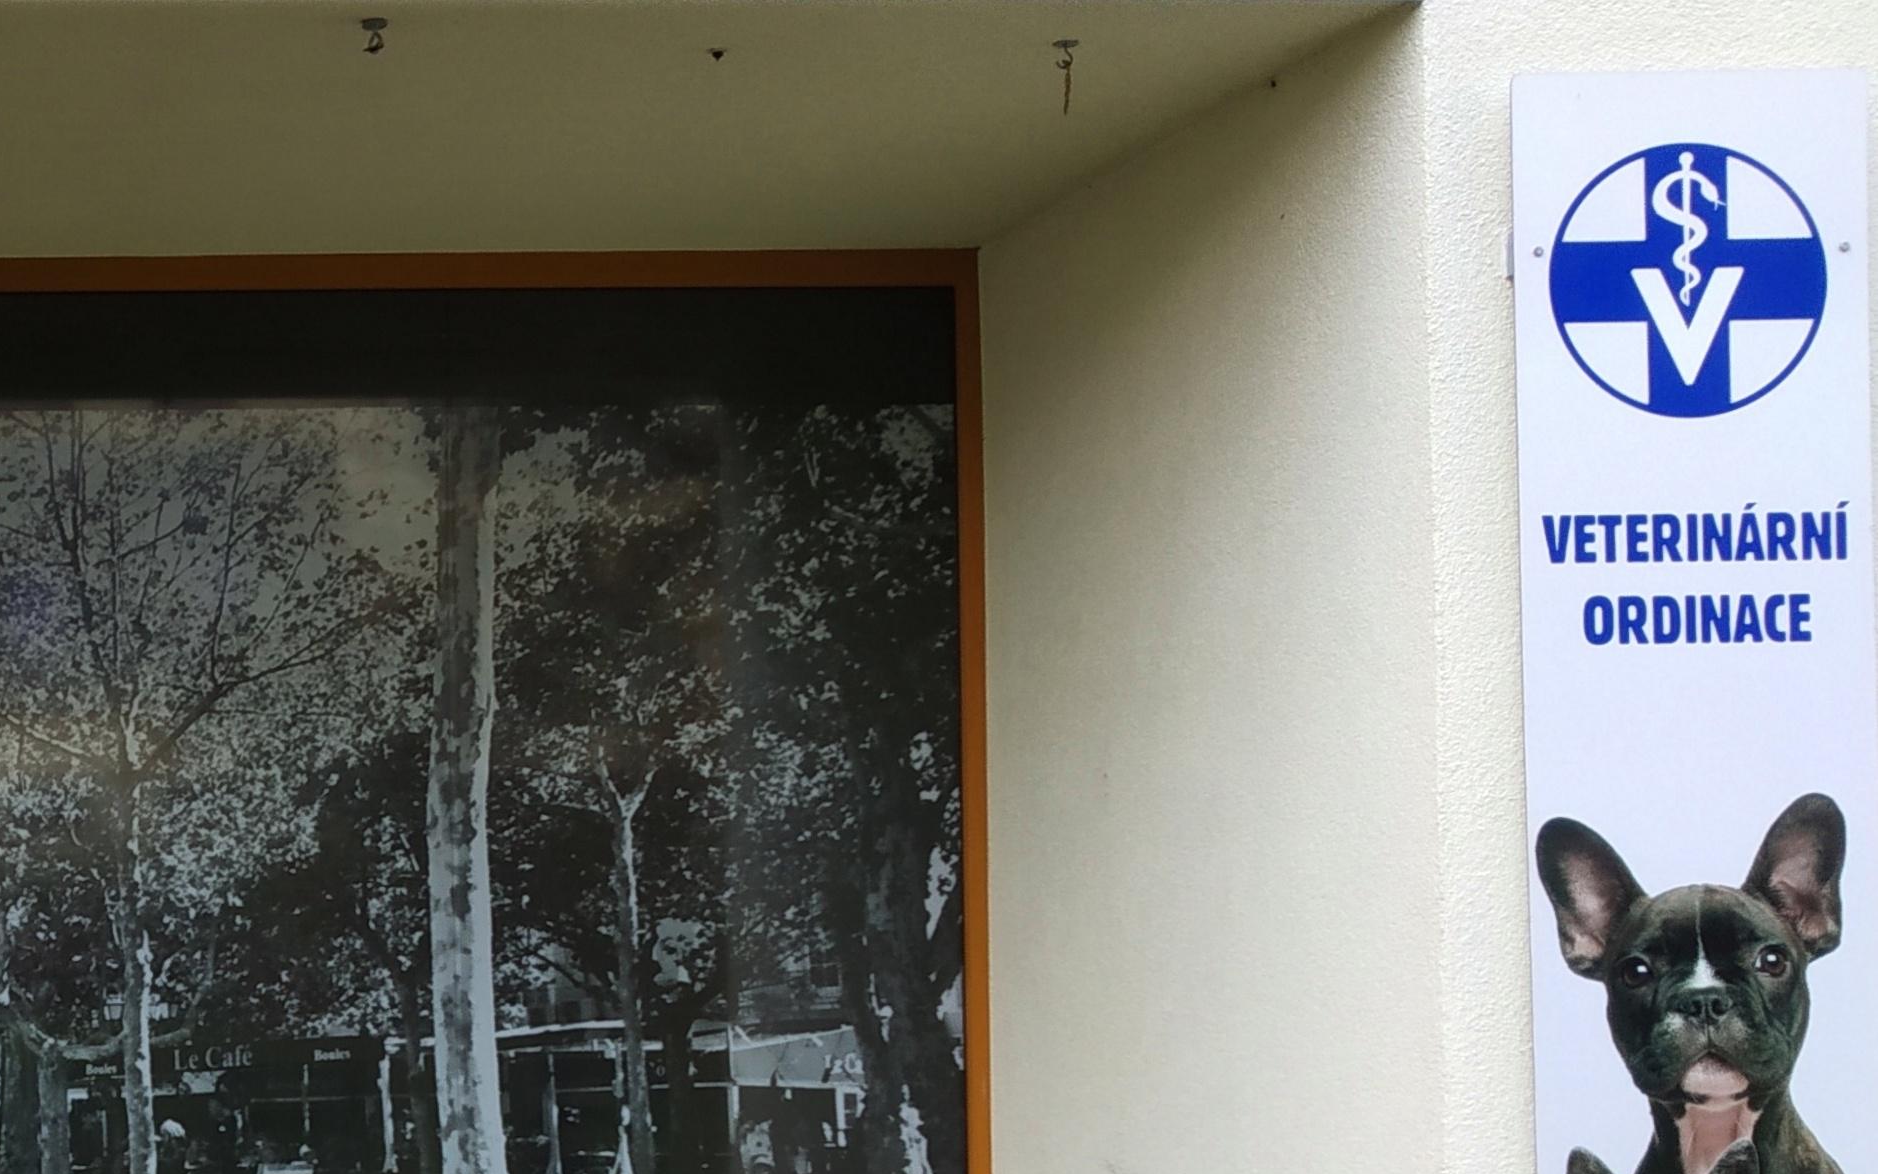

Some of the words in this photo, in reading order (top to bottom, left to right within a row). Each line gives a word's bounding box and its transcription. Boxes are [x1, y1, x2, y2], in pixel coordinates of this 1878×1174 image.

[1630, 266, 1744, 386] V
[1542, 501, 1850, 564] VETERINÁRNÍ
[1583, 593, 1812, 645] ORDINACE
[85, 1063, 118, 1076] Boules
[173, 1050, 199, 1071] Le
[205, 1044, 254, 1069] Café
[313, 1049, 351, 1063] Boules
